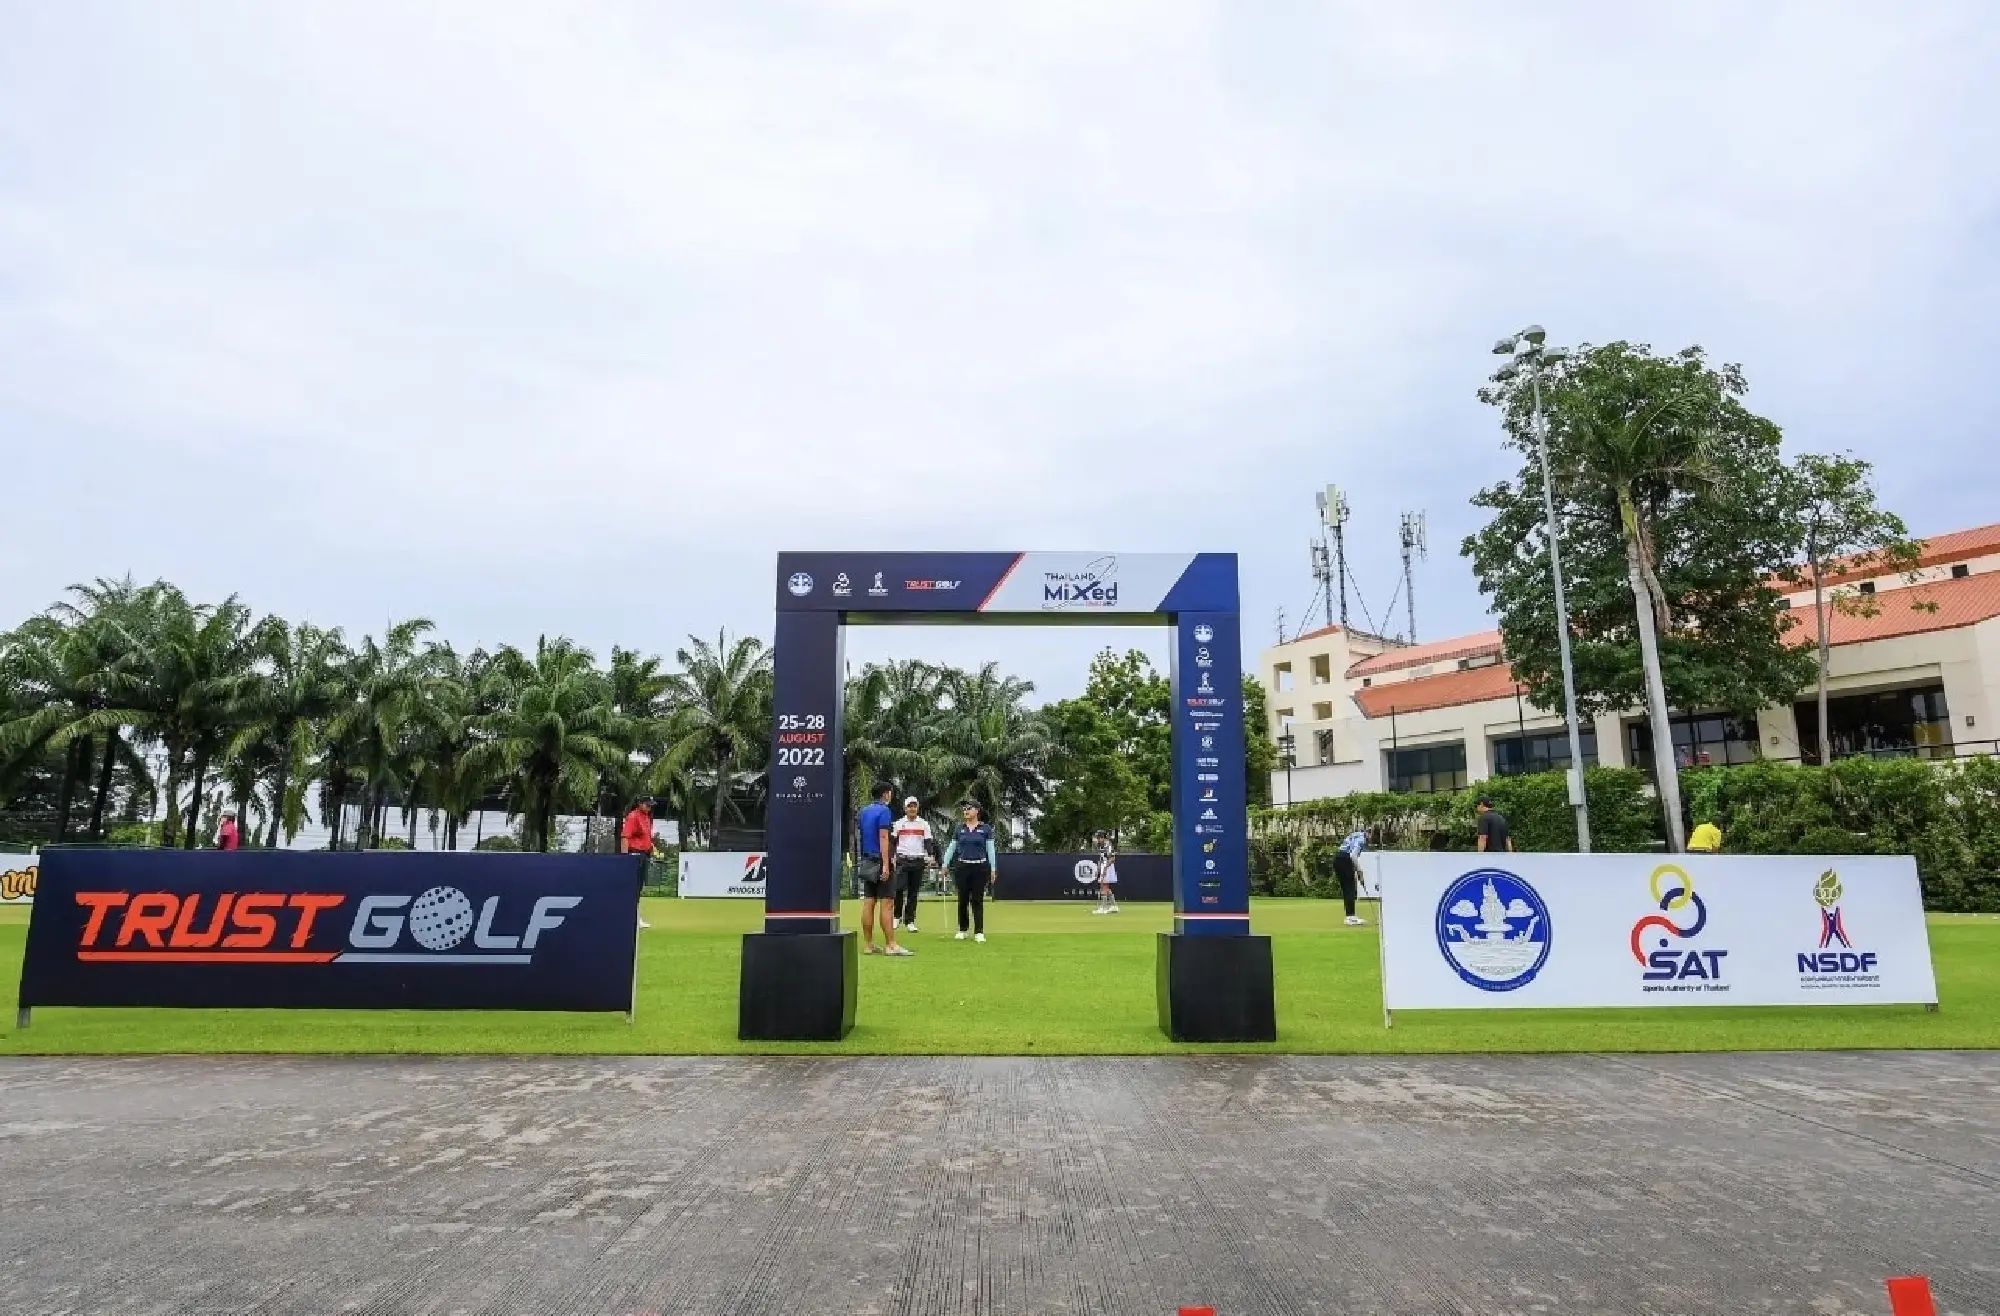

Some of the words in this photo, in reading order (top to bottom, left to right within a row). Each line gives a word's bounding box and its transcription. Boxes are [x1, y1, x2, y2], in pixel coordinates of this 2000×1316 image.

[1044, 572, 1096, 581] THAILAND
[779, 714, 826, 730] 25-28
[778, 733, 826, 744] AUGUST
[778, 747, 825, 766] 2022
[75, 890, 345, 949] TRUST
[348, 885, 583, 951] GOLF
[1642, 950, 1728, 981] SAT
[1797, 952, 1878, 973] NSDF
